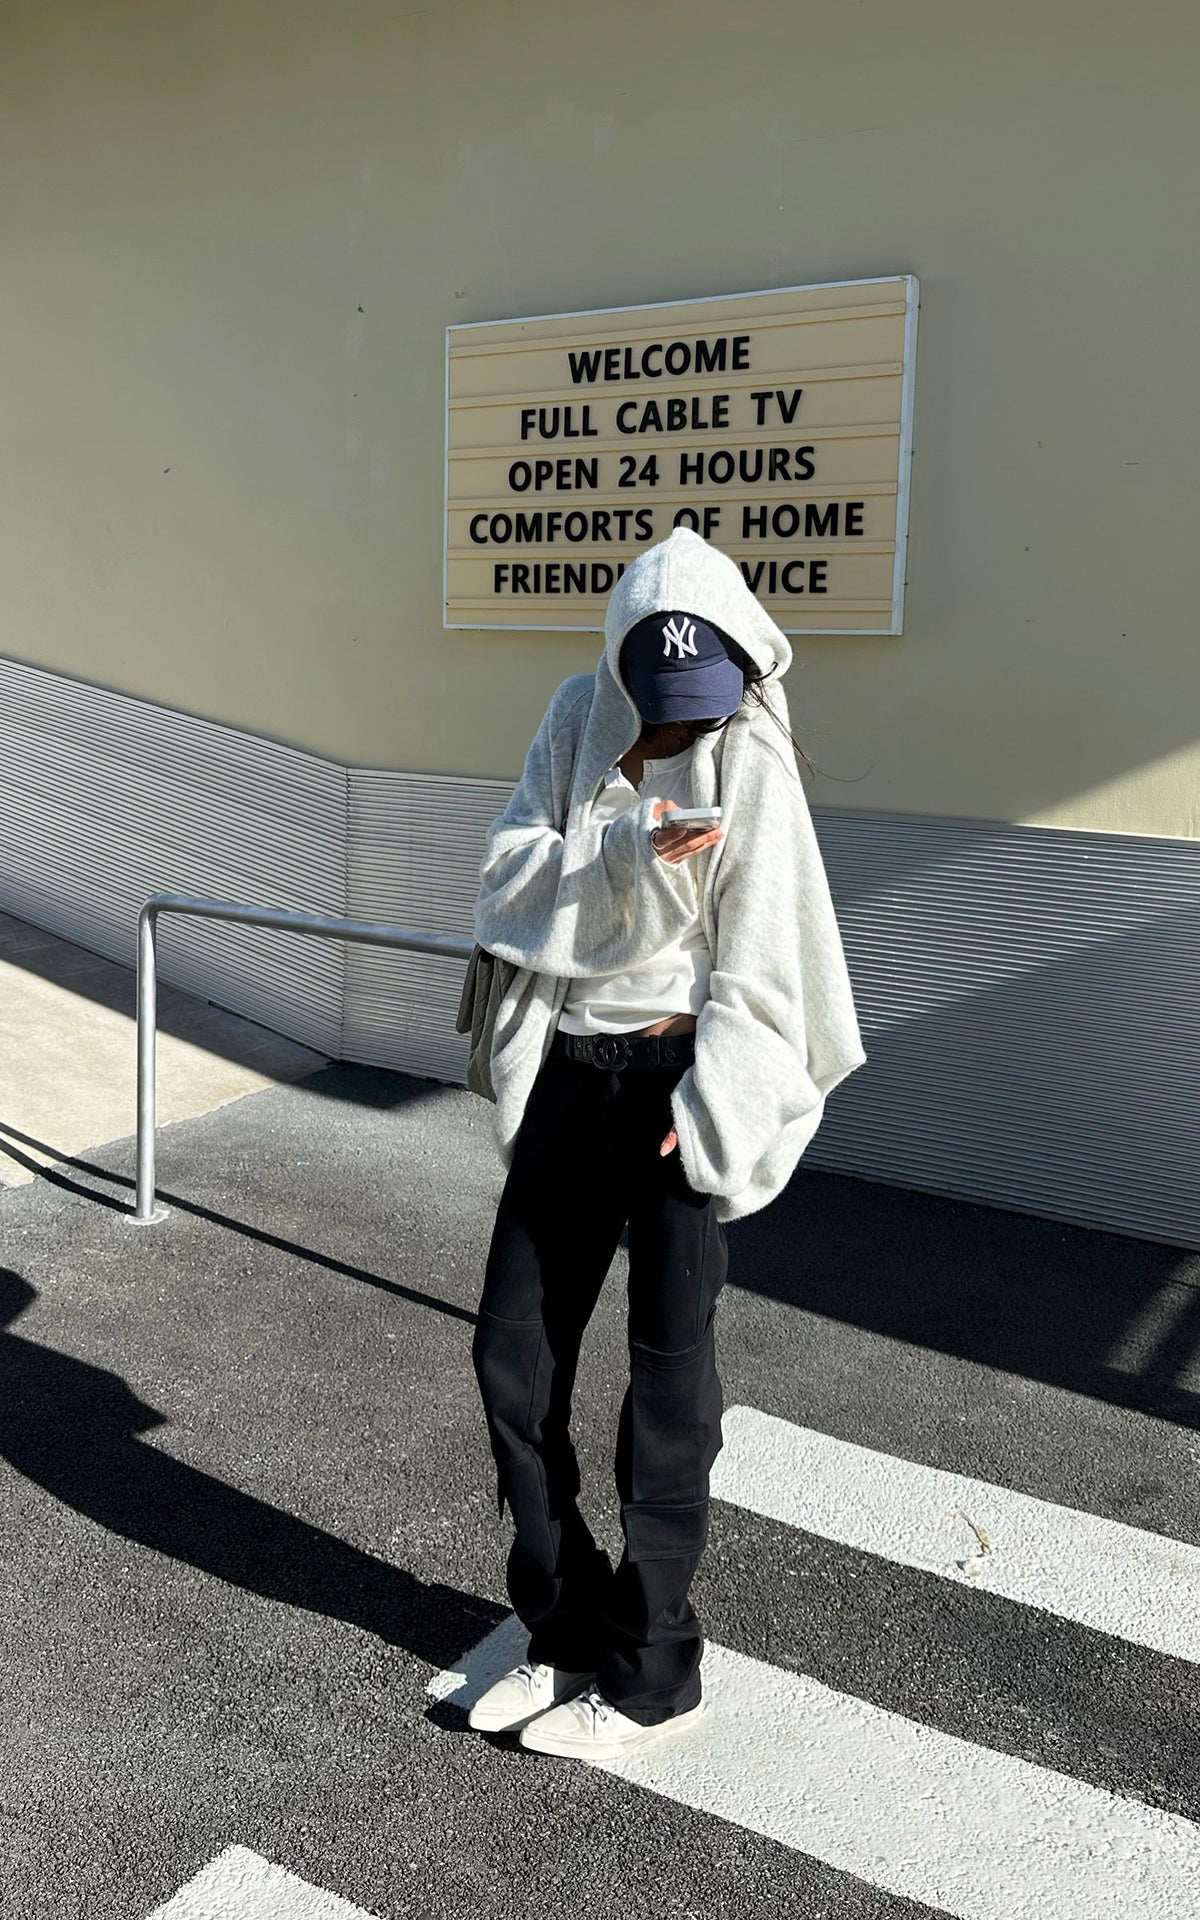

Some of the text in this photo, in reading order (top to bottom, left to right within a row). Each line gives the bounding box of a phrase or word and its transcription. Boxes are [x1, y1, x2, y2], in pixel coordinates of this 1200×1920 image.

[568, 336, 750, 383] WELCOME
[521, 389, 802, 440] FULL CABLE TV
[509, 446, 815, 492] OPEN 24 HOURS
[470, 502, 864, 544] COMFORTS OF HOME
[494, 561, 827, 594] FRIEND VICE
[661, 616, 699, 659] NY
